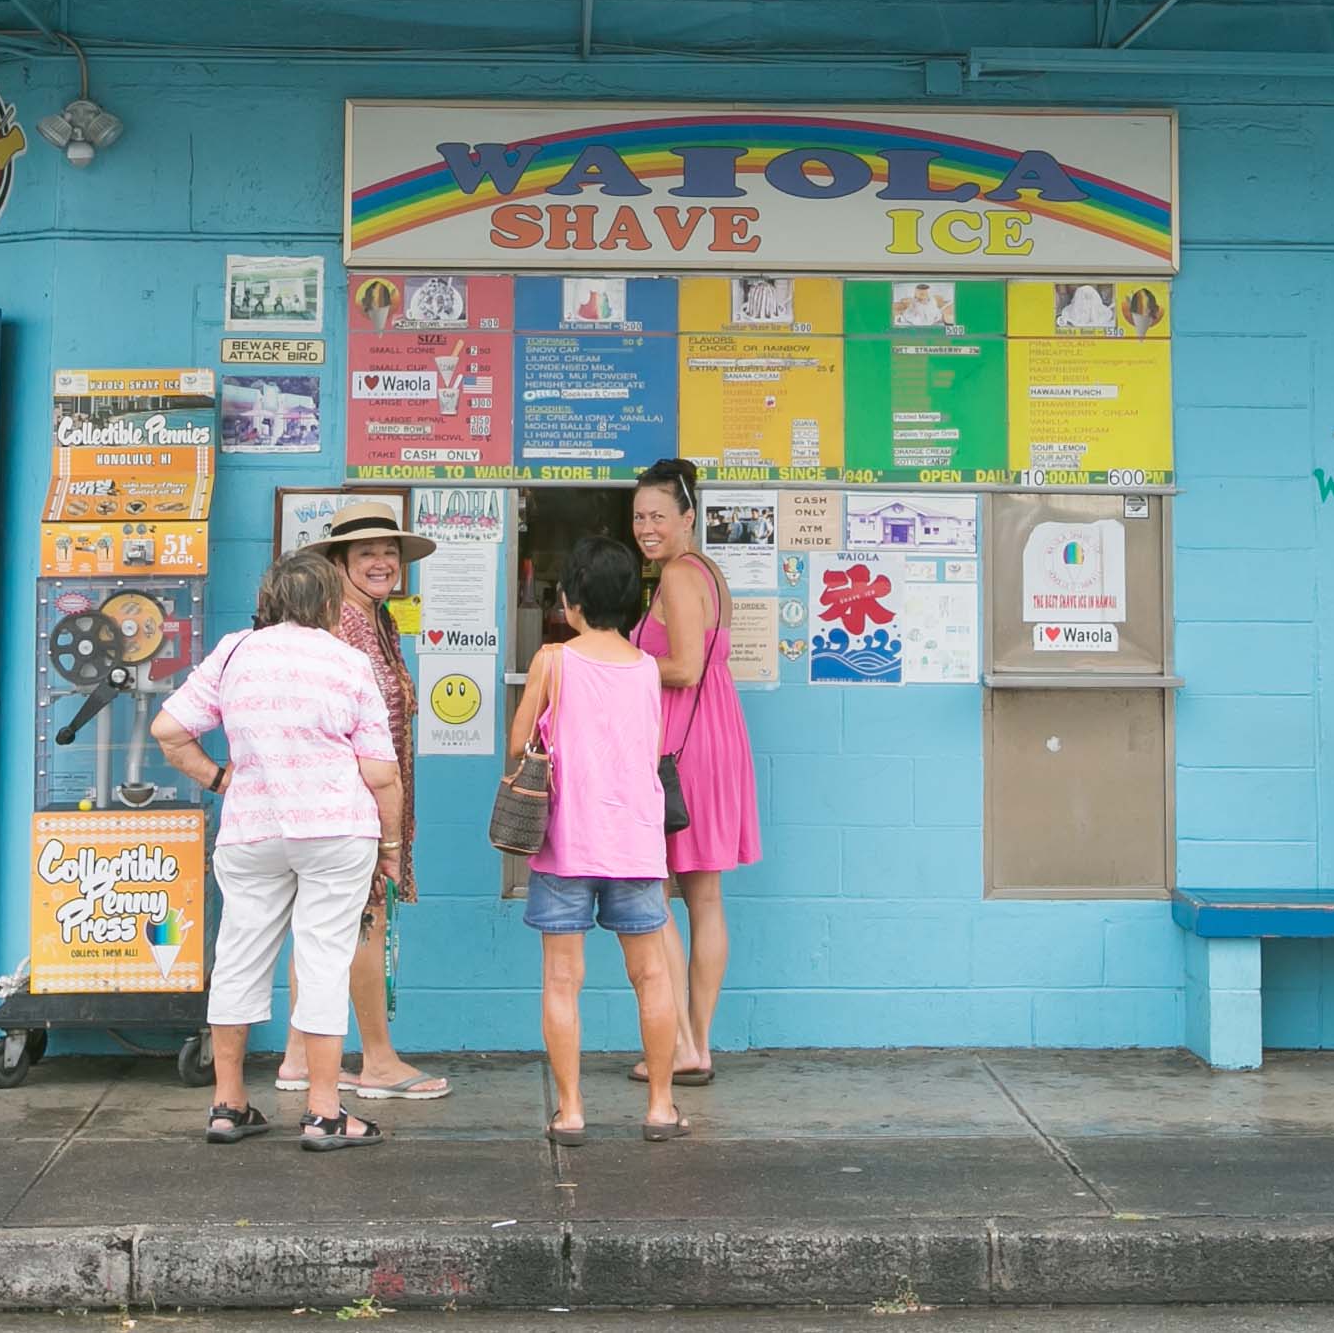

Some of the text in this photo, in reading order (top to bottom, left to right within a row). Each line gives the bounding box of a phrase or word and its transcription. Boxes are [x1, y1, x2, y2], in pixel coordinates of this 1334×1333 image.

[436, 142, 1091, 200] WAIOLA
[489, 204, 1035, 255] SHAVE ICE
[418, 334, 447, 344] SIZE:
[232, 341, 315, 352] BEWARE OF
[228, 351, 318, 362] ATTACK BIRD
[369, 364, 402, 372] SMALL
[358, 375, 431, 391] i Waiola
[584, 381, 645, 389] CHOCOLATE
[1030, 388, 1102, 396] HAWAIIAN PUNCH
[620, 415, 664, 423] VANILLA)
[793, 419, 817, 427] GUAVA
[58, 414, 210, 446] Collectible Pennies
[370, 425, 428, 433] JUMBO BOWL
[1058, 444, 1086, 452] LEMON
[161, 452, 172, 465] HI
[403, 450, 437, 460] CASH
[357, 465, 610, 479] WELCOME TO WAIOLA STORE !!!
[717, 467, 770, 480] HAWAII
[778, 467, 826, 480] SINCE
[919, 470, 962, 483] OPEN
[975, 470, 1017, 484] DAILY
[794, 496, 827, 504] CASH
[417, 489, 501, 524] ALOHA
[795, 509, 827, 517] ONLY
[790, 537, 832, 545] INSIDE
[160, 555, 193, 564] EACH
[837, 553, 880, 561] WAIOLA
[1034, 594, 1117, 609] THE BEST SHAVE ICE IN HAWAII
[422, 629, 497, 646] i Waiola
[1040, 627, 1112, 642] i Waiola
[431, 729, 481, 742] WAIOLA
[38, 838, 180, 884] Collectible
[79, 877, 169, 923] Penny
[56, 897, 137, 944] Press
